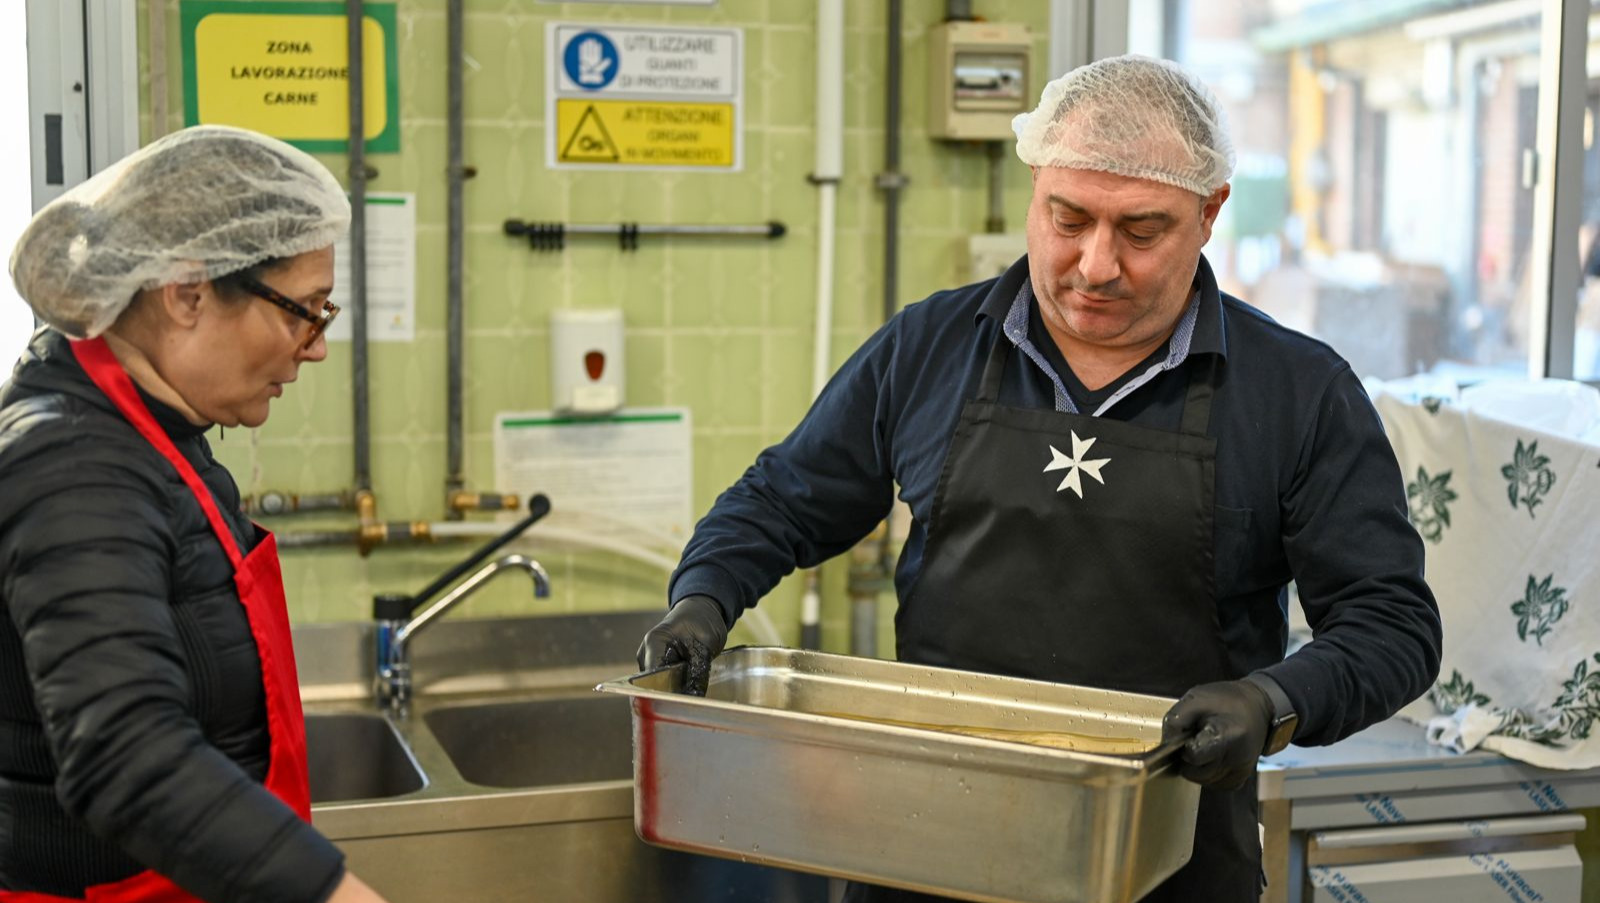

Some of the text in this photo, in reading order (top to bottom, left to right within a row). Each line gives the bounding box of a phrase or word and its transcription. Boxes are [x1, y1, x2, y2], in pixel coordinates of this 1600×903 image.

[266, 41, 312, 54] ZONA
[623, 34, 717, 54] UTILIZZARE
[230, 66, 350, 79] LAVORAZIONE
[638, 75, 720, 91] PROTEZIONE
[263, 92, 318, 105] CARNE
[622, 106, 724, 126] ATTENZIONE
